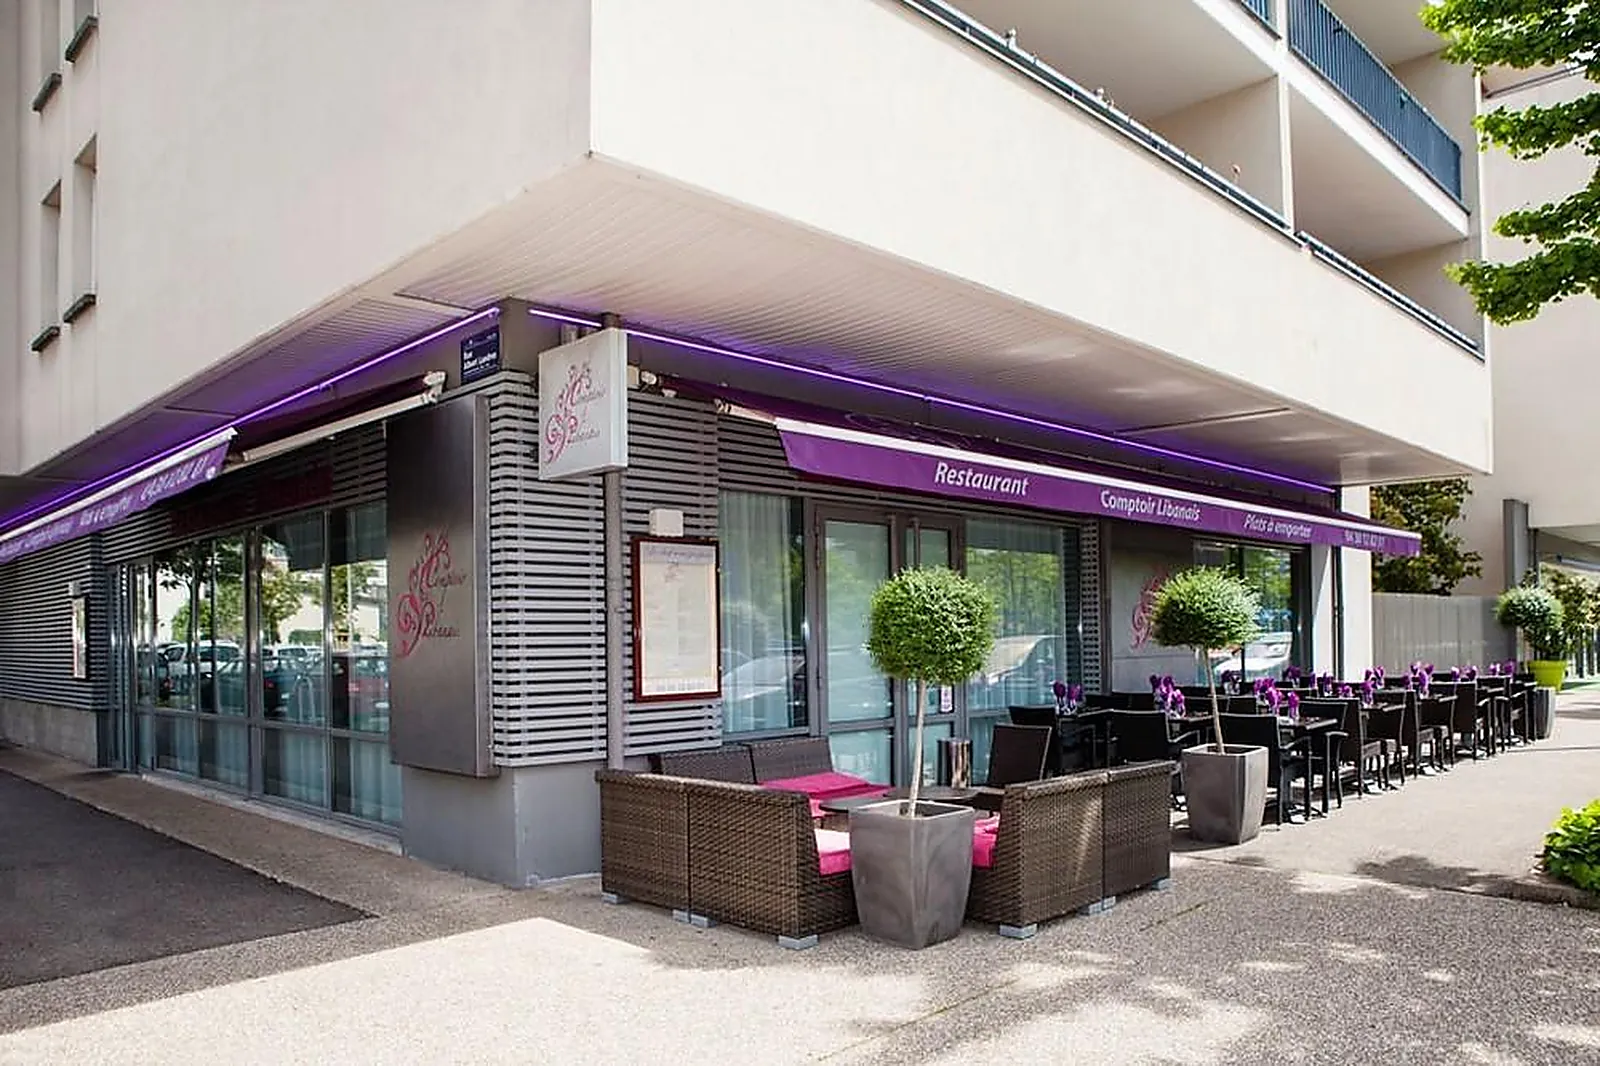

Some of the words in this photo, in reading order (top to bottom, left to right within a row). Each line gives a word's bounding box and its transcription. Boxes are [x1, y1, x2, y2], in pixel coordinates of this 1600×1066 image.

[934, 461, 1029, 496] Restaurant
[1100, 490, 1156, 517] Comptoir
[1156, 498, 1201, 522] Libanais
[1243, 514, 1267, 533] Plats
[1274, 521, 1312, 539] emporter
